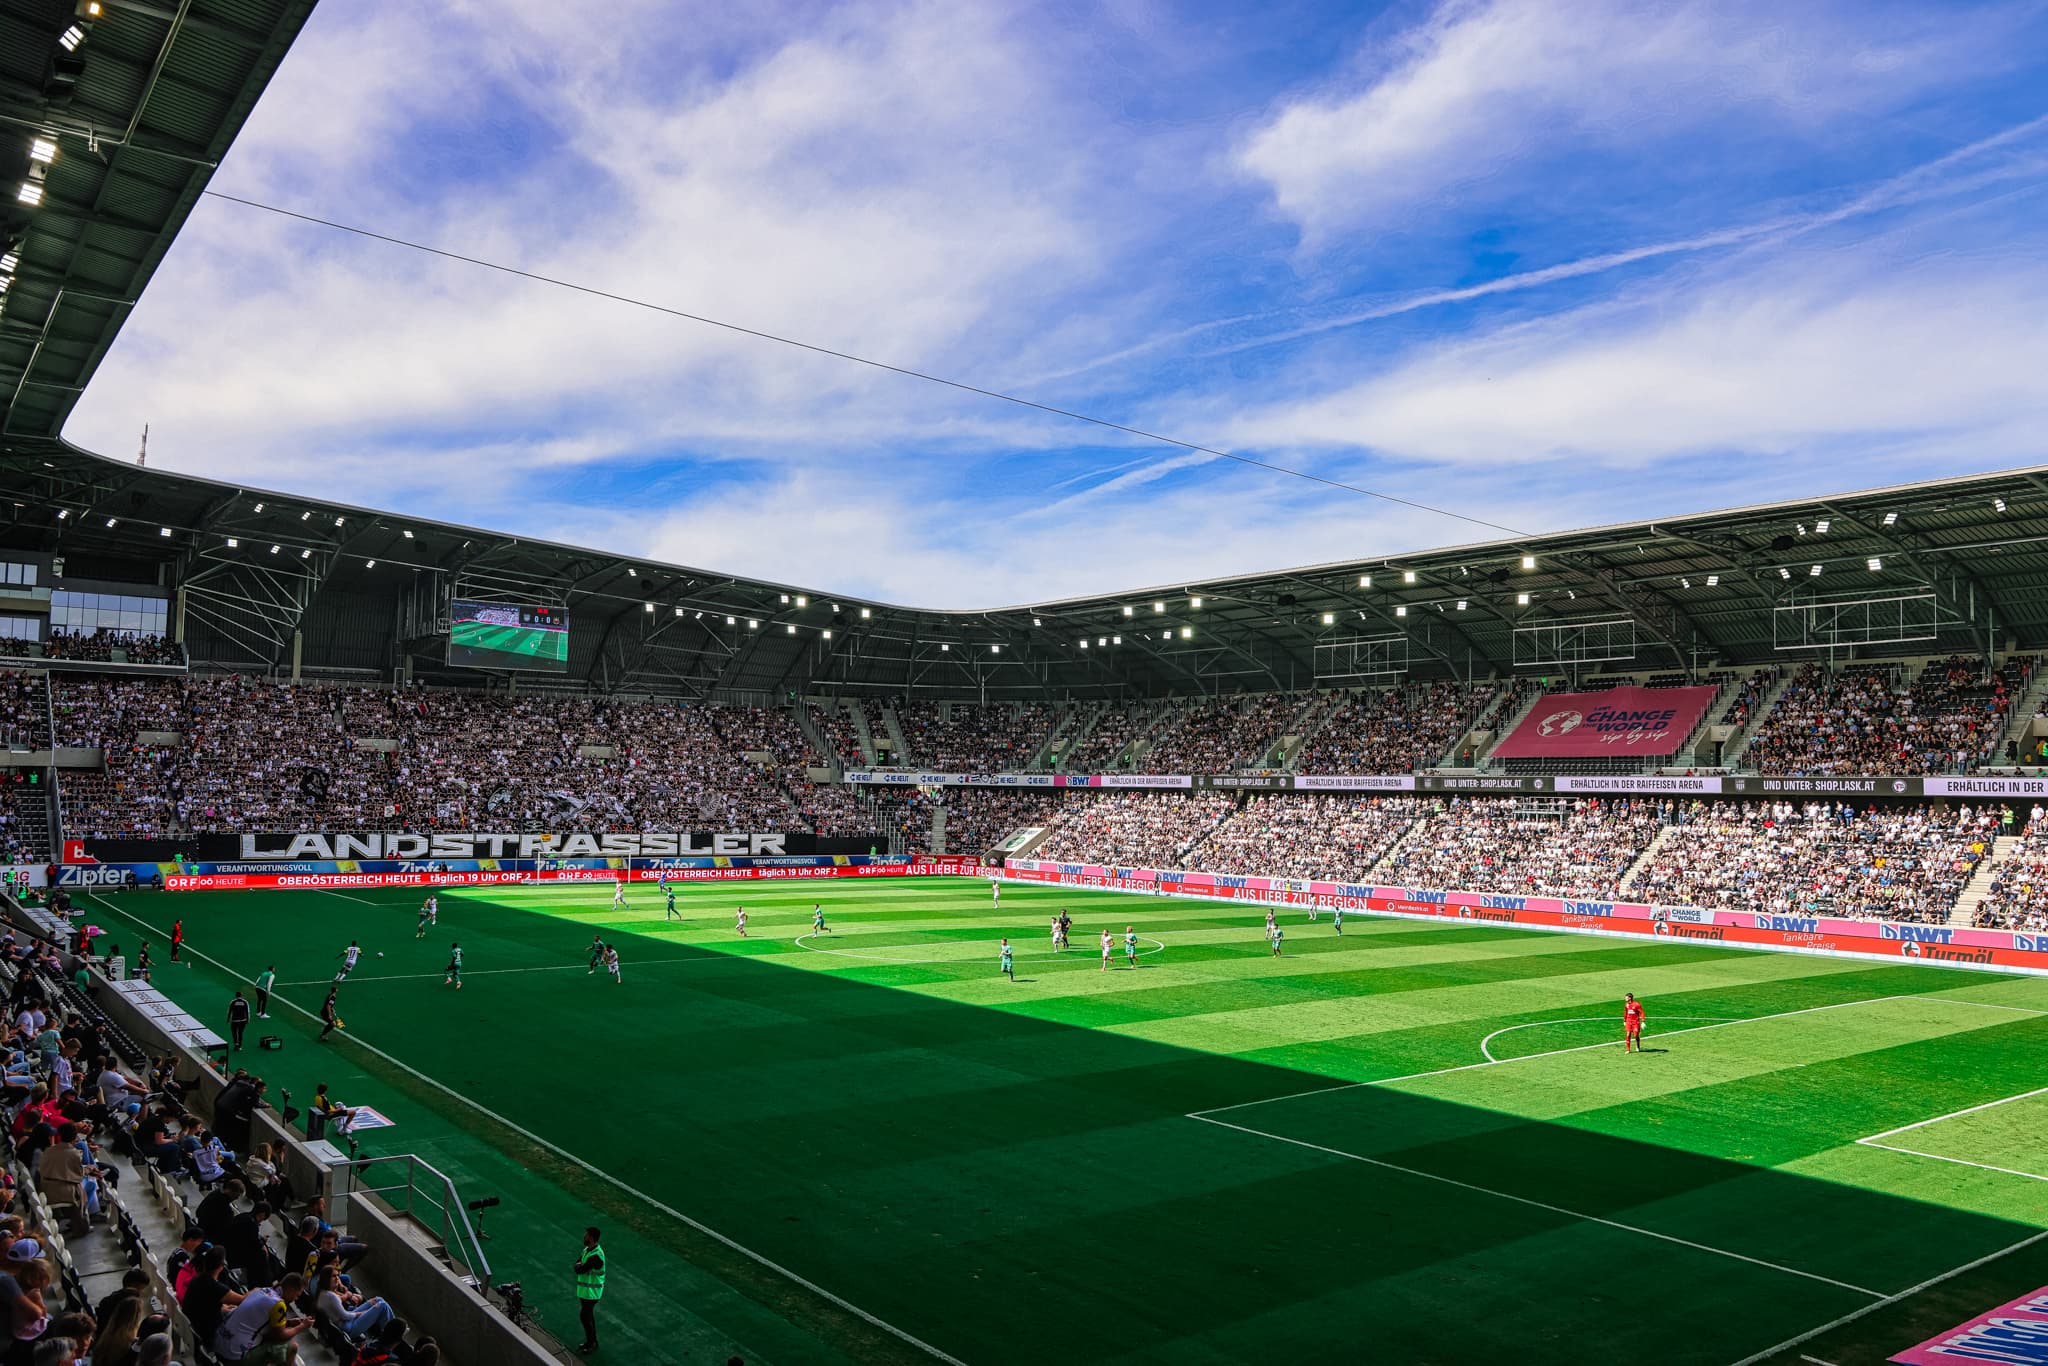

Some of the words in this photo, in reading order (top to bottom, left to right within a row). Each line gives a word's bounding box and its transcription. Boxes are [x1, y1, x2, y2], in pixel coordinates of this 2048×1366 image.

[1586, 710, 1677, 722] CHANGE
[1597, 721, 1669, 732] WORLD
[1073, 776, 1090, 786] BWT
[1306, 778, 1334, 787] ERHÄLTLICH
[1340, 779, 1353, 787] DER
[1354, 779, 1386, 787] RAIFFEISEN
[1388, 779, 1402, 787] ARENA
[1444, 779, 1457, 787] UND
[1571, 778, 1610, 788] ERHÄLTLICH
[1611, 779, 1619, 788] IN
[1621, 779, 1634, 788] DER
[1636, 779, 1676, 789] RAIFFEISEN
[1678, 779, 1703, 789] ARENA
[1763, 781, 1781, 791] UND
[1783, 781, 1813, 792] UNTER:
[1815, 781, 1876, 792] SHOP.LASK.AT
[1947, 780, 2005, 792] ERHÄLTLICH
[2009, 781, 2020, 792] IN
[2023, 782, 2044, 793] DER
[240, 832, 786, 860] LANDSTRASSLER
[535, 860, 584, 871] Zifer
[752, 857, 817, 866] VERANTWORTUNGSVOLL
[216, 864, 312, 873] VERANTWORTUNGSVOLL
[724, 869, 752, 878] HEUTE
[759, 868, 785, 878] täglich
[788, 868, 796, 876] 19
[798, 867, 811, 876] Uhr
[814, 868, 831, 876] ORF
[906, 864, 927, 875] AUS
[930, 864, 957, 875] LIEBE
[959, 864, 974, 876] ZUR
[1064, 864, 1083, 875] BWT
[59, 865, 131, 886] Zipfer
[168, 876, 198, 887] ORF
[277, 874, 382, 885] OBERÖSTERREICH
[385, 874, 421, 884] HEUTE
[430, 873, 465, 884] täglich
[467, 874, 478, 882] 19
[481, 873, 499, 882] Uhr
[501, 873, 522, 881] ORF
[525, 873, 531, 881] 2
[1060, 875, 1078, 885] AUS
[1080, 876, 1102, 887] LIEBE
[1104, 878, 1122, 888] ZUR
[1162, 873, 1185, 884] BWT
[1222, 876, 1247, 888] BWT
[1233, 889, 1255, 901] AUS
[1259, 891, 1288, 904] LIEBE
[1292, 892, 1315, 906] ZUR
[1345, 886, 1374, 899] BWT
[1415, 890, 1446, 904] BWT
[1492, 895, 1526, 911] BWT
[1473, 909, 1515, 922] Turmöl
[1576, 902, 1613, 917] BWT
[1671, 909, 1701, 917] CHANGE
[1771, 916, 1818, 933] BWT
[1671, 924, 1724, 940] Turmöl
[1782, 932, 1824, 943] Tankbare
[1899, 925, 1953, 945] BWT
[1806, 940, 1836, 950] Preise
[1925, 946, 1993, 965] Turmöl
